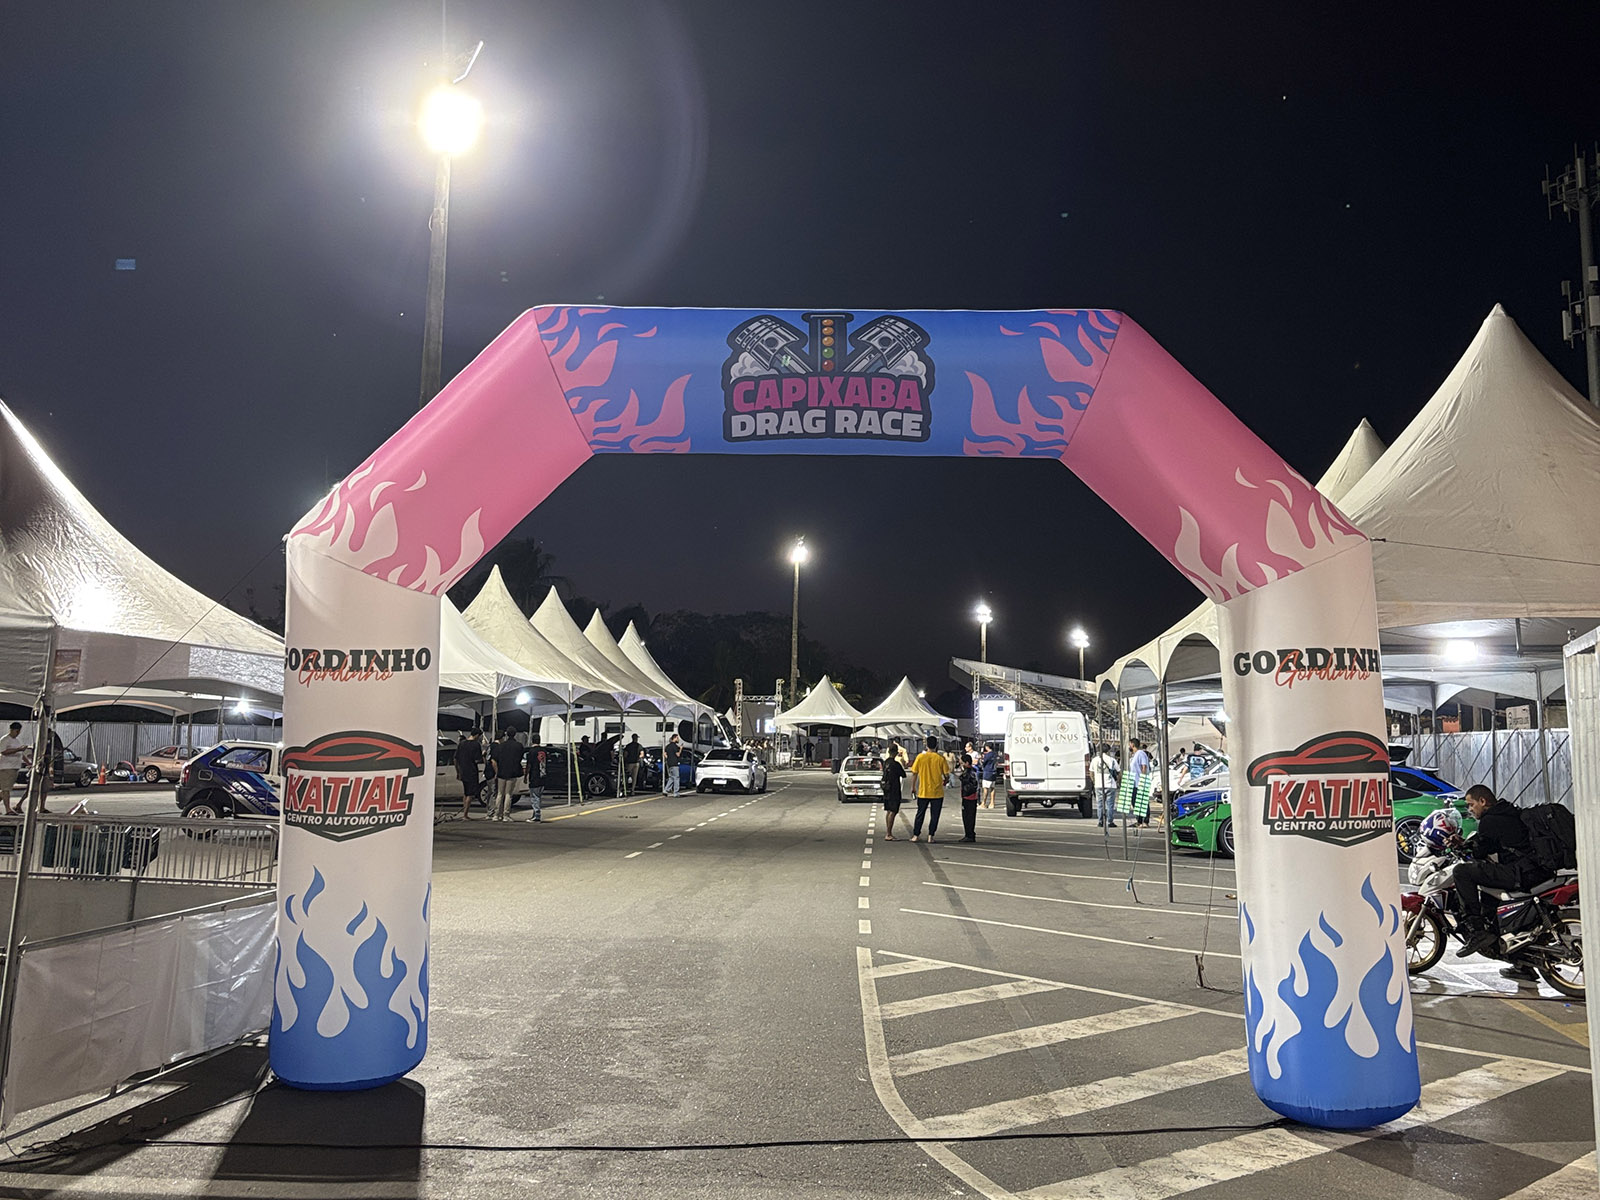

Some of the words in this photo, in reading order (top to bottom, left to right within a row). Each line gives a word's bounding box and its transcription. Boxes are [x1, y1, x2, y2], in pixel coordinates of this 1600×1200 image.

[733, 376, 922, 412] CAPIXABA
[731, 409, 826, 437] DRAG
[835, 409, 923, 437] RACE
[298, 650, 393, 688] Gordinho
[1275, 650, 1370, 689] Gordinho
[1049, 733, 1079, 741] VENUS
[285, 773, 408, 813] KATIAL
[1269, 779, 1392, 818] KATIAL
[287, 812, 323, 825] CENTRO
[325, 813, 404, 826] AUTOMOTIVO
[1274, 820, 1326, 831] CENTRO
[1329, 819, 1391, 831] AUTOMOTIVO
